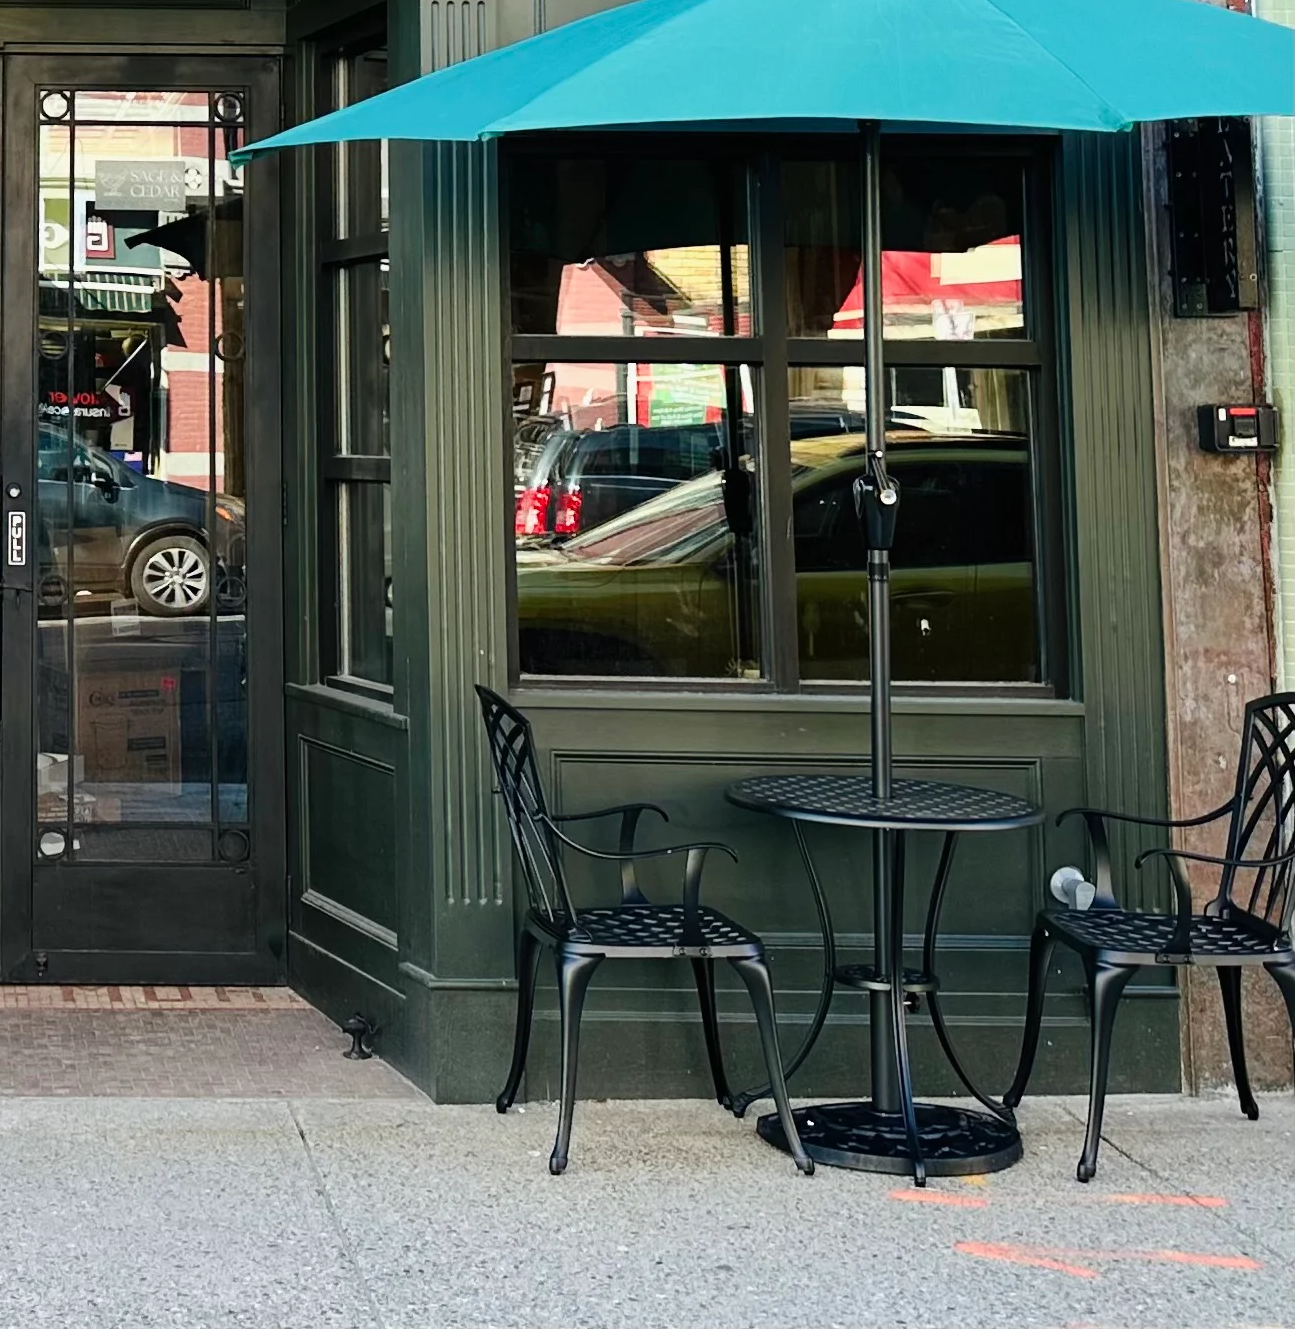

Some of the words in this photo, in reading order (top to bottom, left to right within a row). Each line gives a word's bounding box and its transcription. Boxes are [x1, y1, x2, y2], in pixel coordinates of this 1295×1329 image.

[130, 170, 167, 183] SAGE
[171, 171, 184, 183] &
[130, 184, 181, 197] CEDAR
[11, 515, 22, 562] PULL
